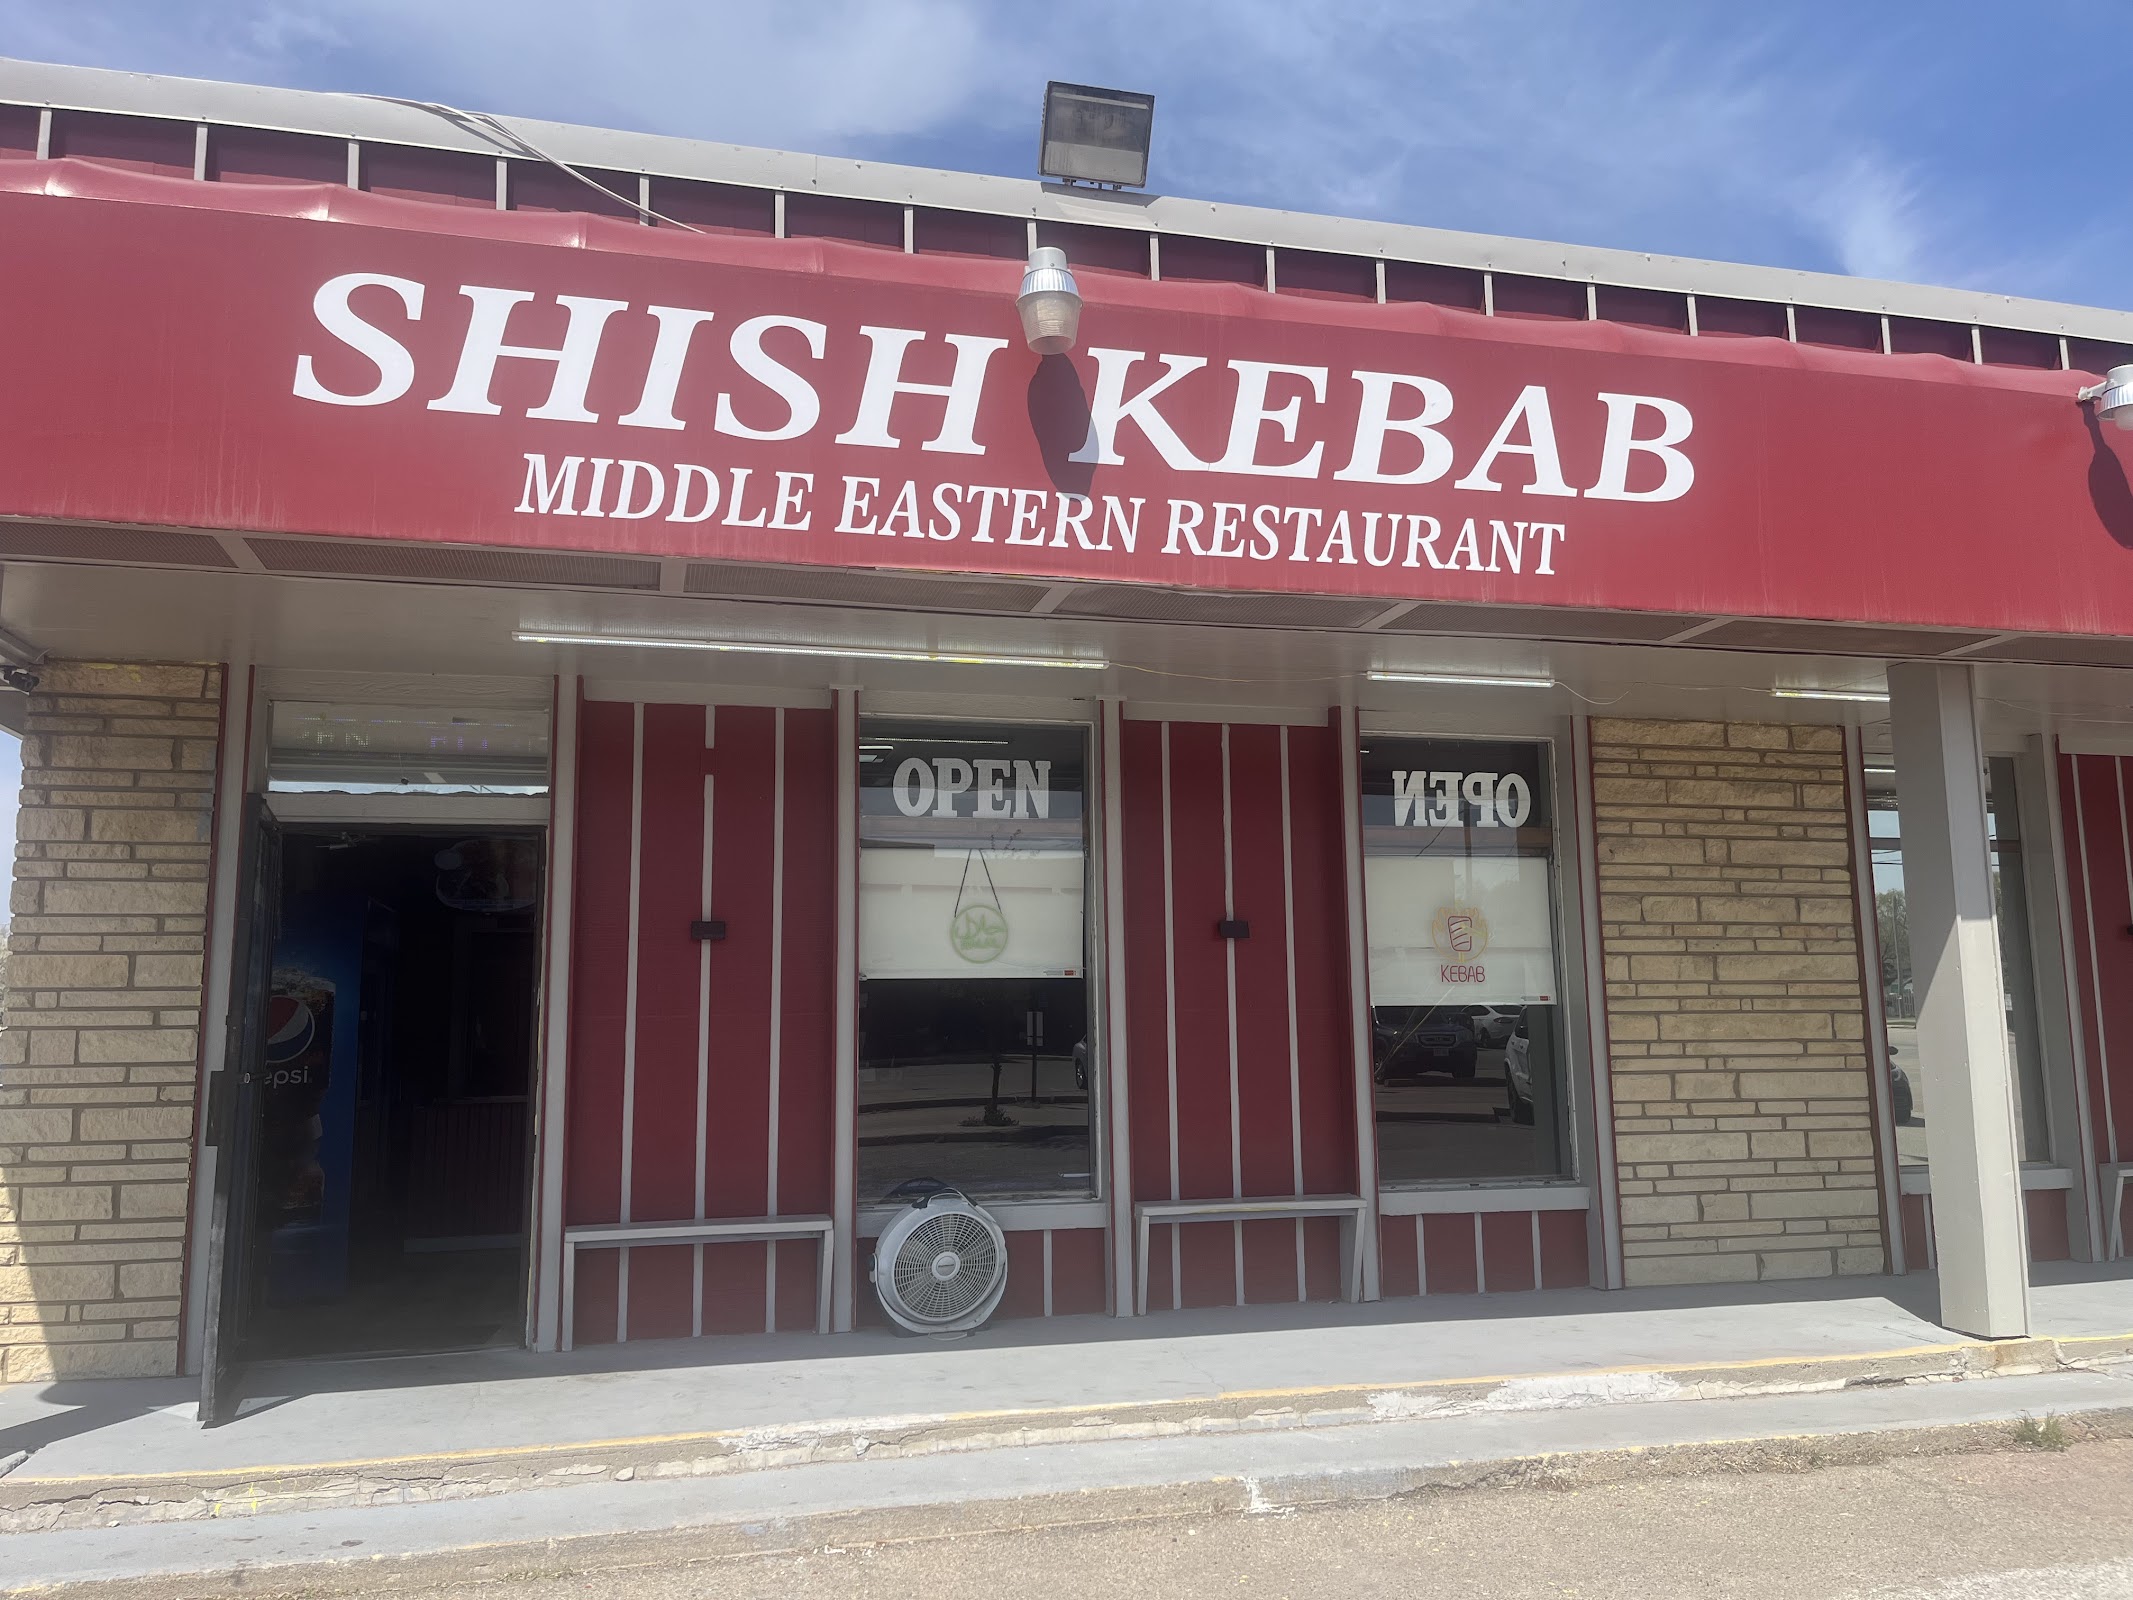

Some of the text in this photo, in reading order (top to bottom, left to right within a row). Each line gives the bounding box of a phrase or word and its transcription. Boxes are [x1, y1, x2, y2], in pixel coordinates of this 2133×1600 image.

[292, 272, 1696, 503] SHISH KEBAB
[513, 452, 1567, 576] MIDDLE EASTERN RESTAURANT
[892, 757, 1052, 819] OPEN
[1440, 963, 1486, 984] KEBAB
[264, 1065, 309, 1089] psi
